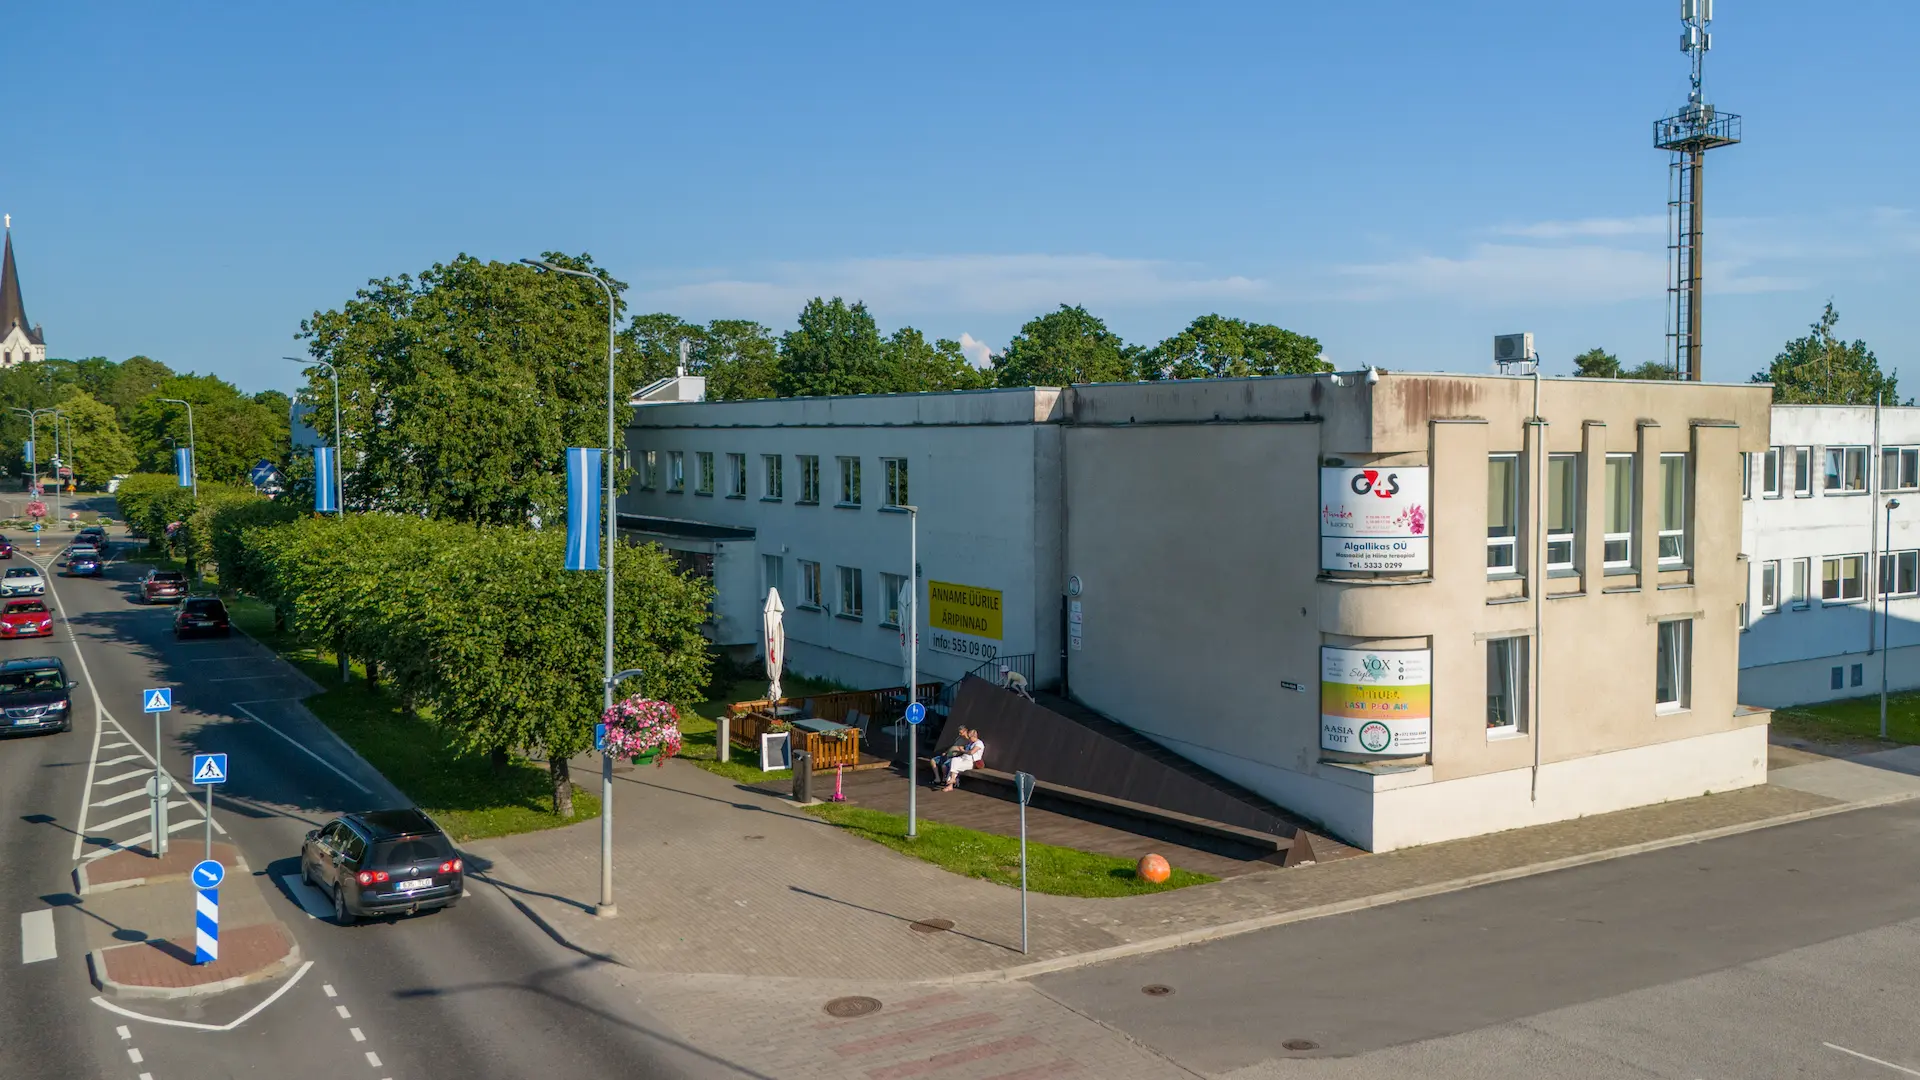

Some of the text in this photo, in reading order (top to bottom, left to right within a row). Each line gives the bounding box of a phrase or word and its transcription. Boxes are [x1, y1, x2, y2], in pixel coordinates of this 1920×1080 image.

[1351, 470, 1399, 498] G4S
[1344, 541, 1407, 551] Algallikas OÜ
[932, 588, 999, 610] ANNAME ÜÜRILE
[942, 609, 988, 631] ÄRIPINNAD
[933, 633, 950, 649] info:
[952, 638, 967, 653] 555
[969, 641, 979, 656] 09
[981, 644, 997, 659] 002
[1361, 659, 1391, 670] VOX
[1349, 667, 1373, 682] Style
[1324, 724, 1354, 735] AASIA
[1364, 725, 1387, 735] NAMASTE
[1328, 733, 1349, 743] TOIT
